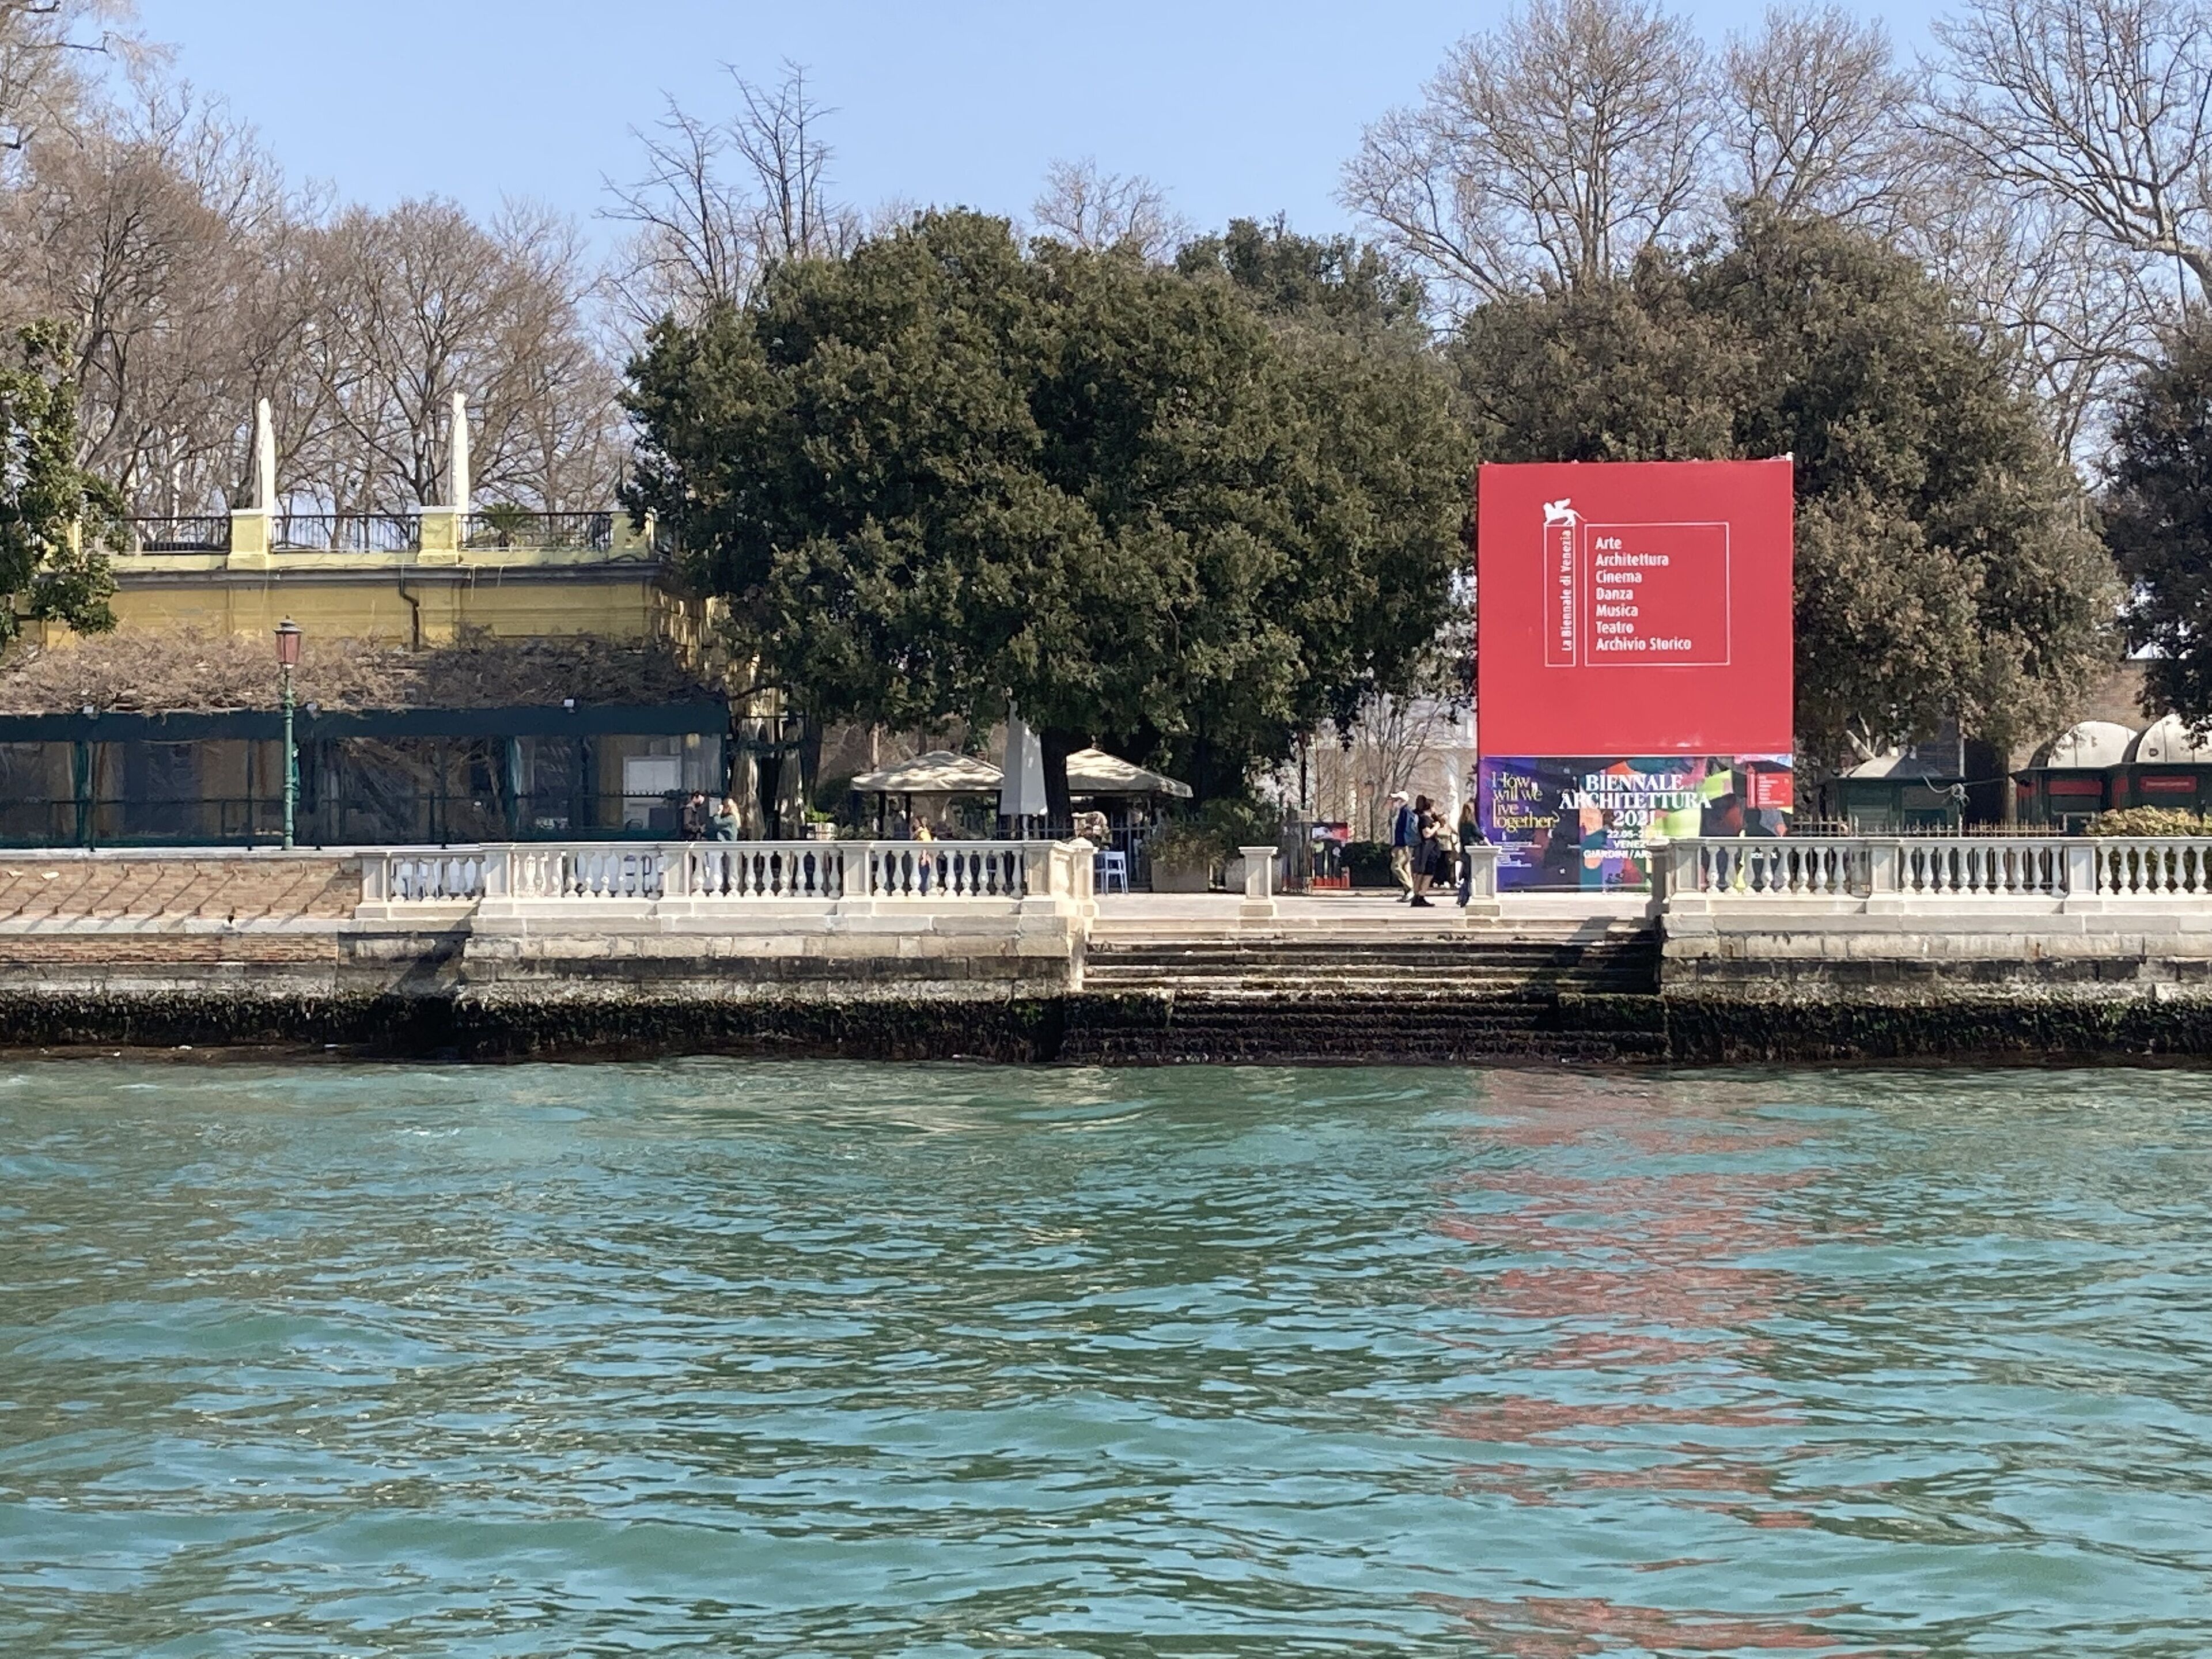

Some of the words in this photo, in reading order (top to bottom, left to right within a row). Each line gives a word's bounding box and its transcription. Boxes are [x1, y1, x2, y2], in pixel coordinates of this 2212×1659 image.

[1595, 536, 1622, 550] Arte
[1559, 530, 1571, 572] Venezia
[1595, 552, 1669, 566] Architettura
[1559, 575, 1571, 586] di
[1595, 570, 1642, 583] Cinema
[1596, 587, 1634, 600] Danza
[1560, 589, 1572, 637] Biennale
[1596, 603, 1638, 617] Musica
[1596, 620, 1634, 634] Teatro
[1562, 640, 1572, 651] La
[1596, 636, 1646, 651] Archivio
[1649, 636, 1692, 650] Storico
[1492, 771, 1531, 788] How
[1585, 774, 1684, 791] BIENNALE
[1492, 786, 1518, 801] will
[1521, 789, 1543, 802] we
[1559, 791, 1712, 809] ARCHITETTURA
[1493, 798, 1520, 816] live
[1493, 810, 1560, 833] together?
[1613, 809, 1656, 826] 2021
[1614, 840, 1647, 849] VENEZ
